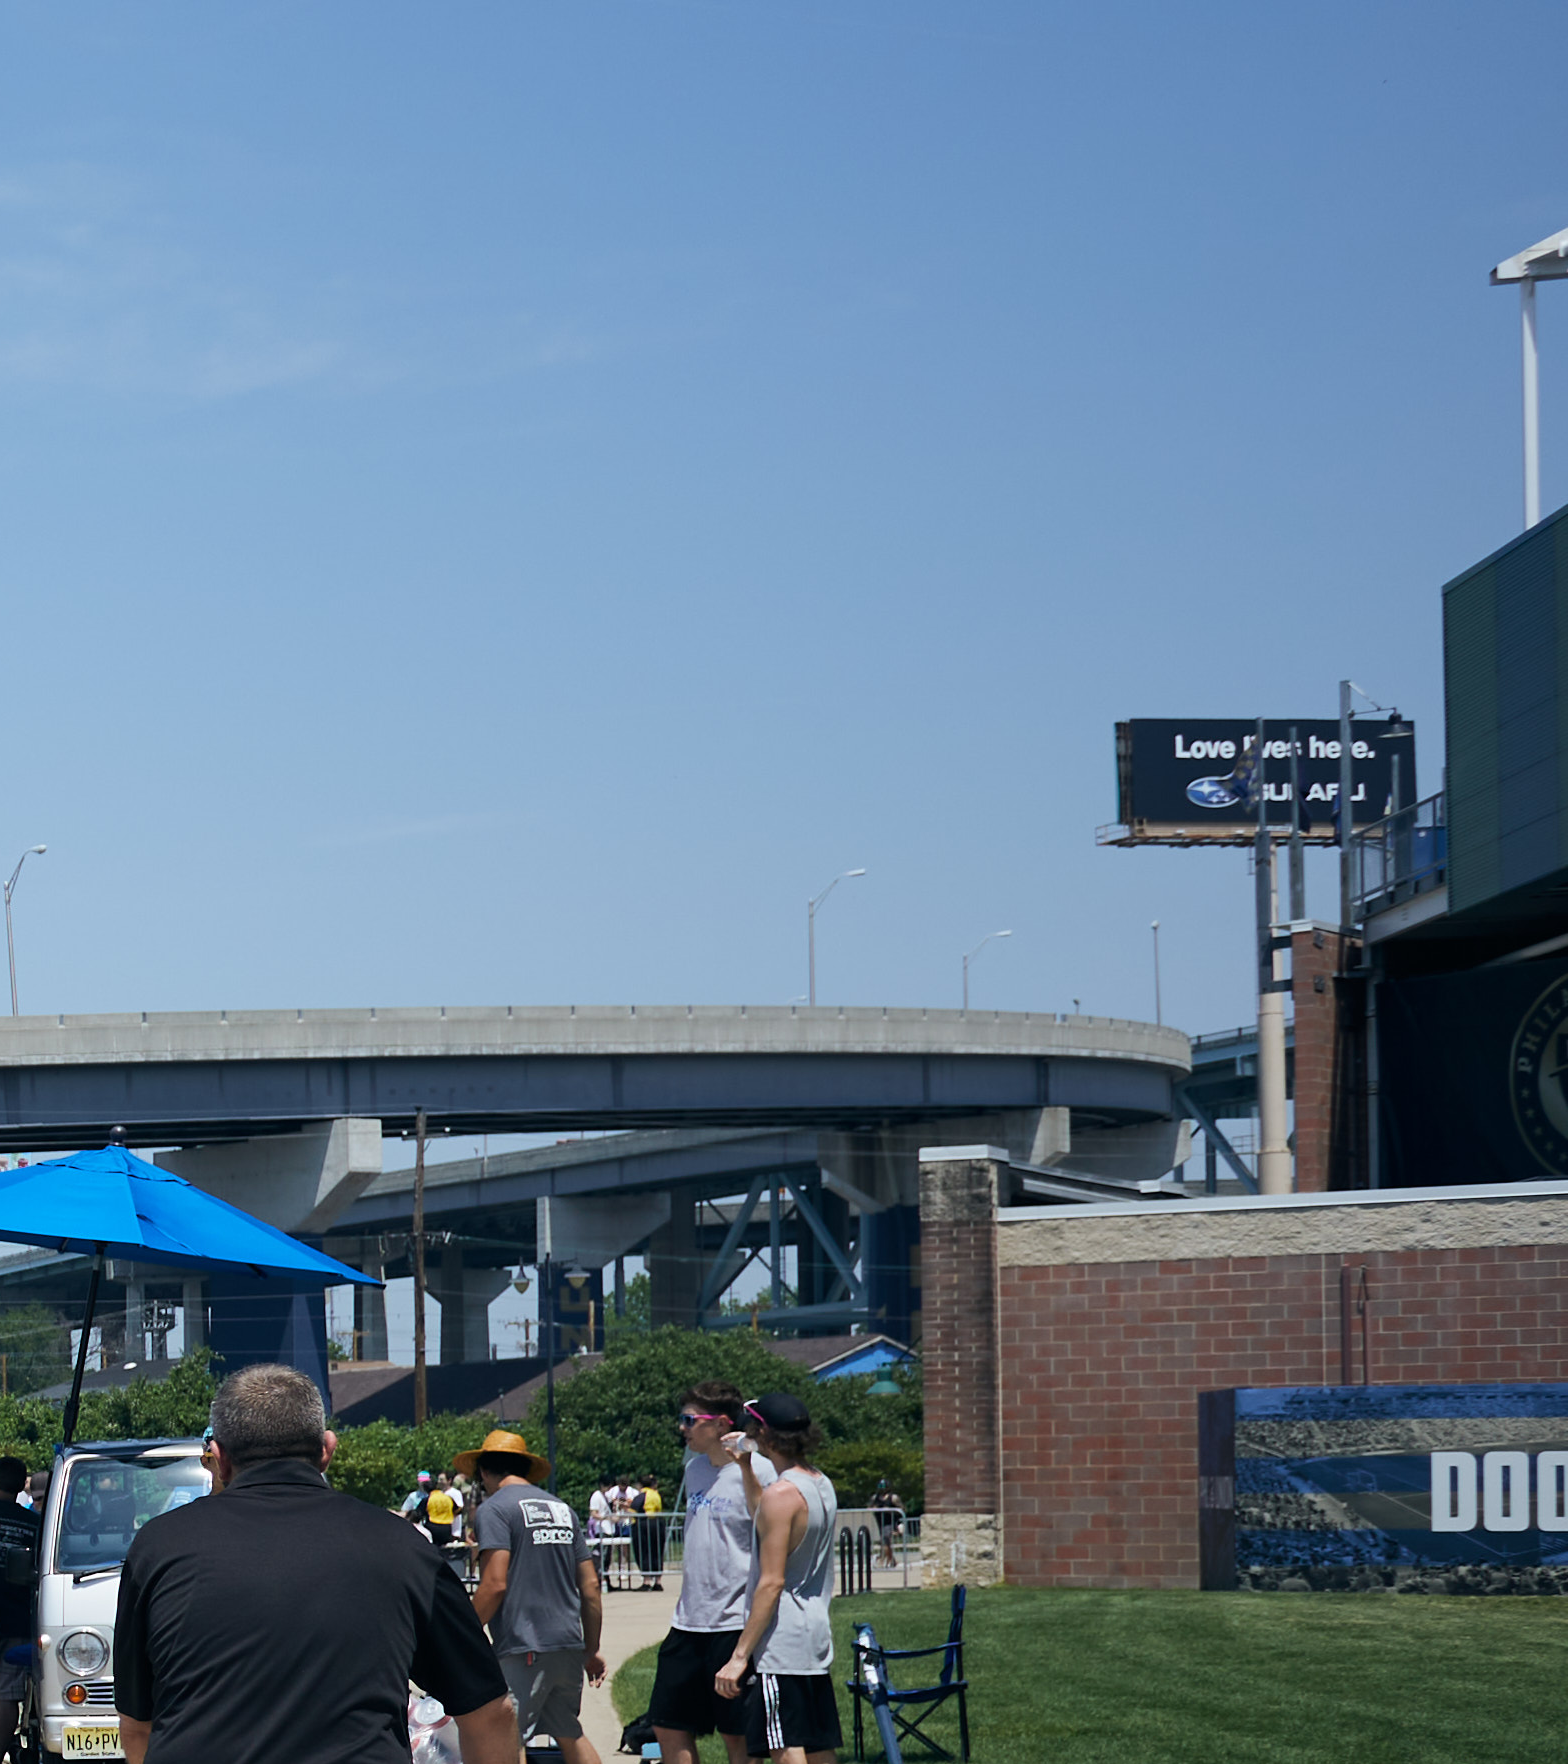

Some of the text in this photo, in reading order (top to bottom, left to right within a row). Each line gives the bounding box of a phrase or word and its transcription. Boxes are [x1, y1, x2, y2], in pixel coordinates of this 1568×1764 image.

[1174, 735, 1236, 759] Love
[1309, 735, 1376, 759] hee.
[66, 1733, 93, 1751] N16
